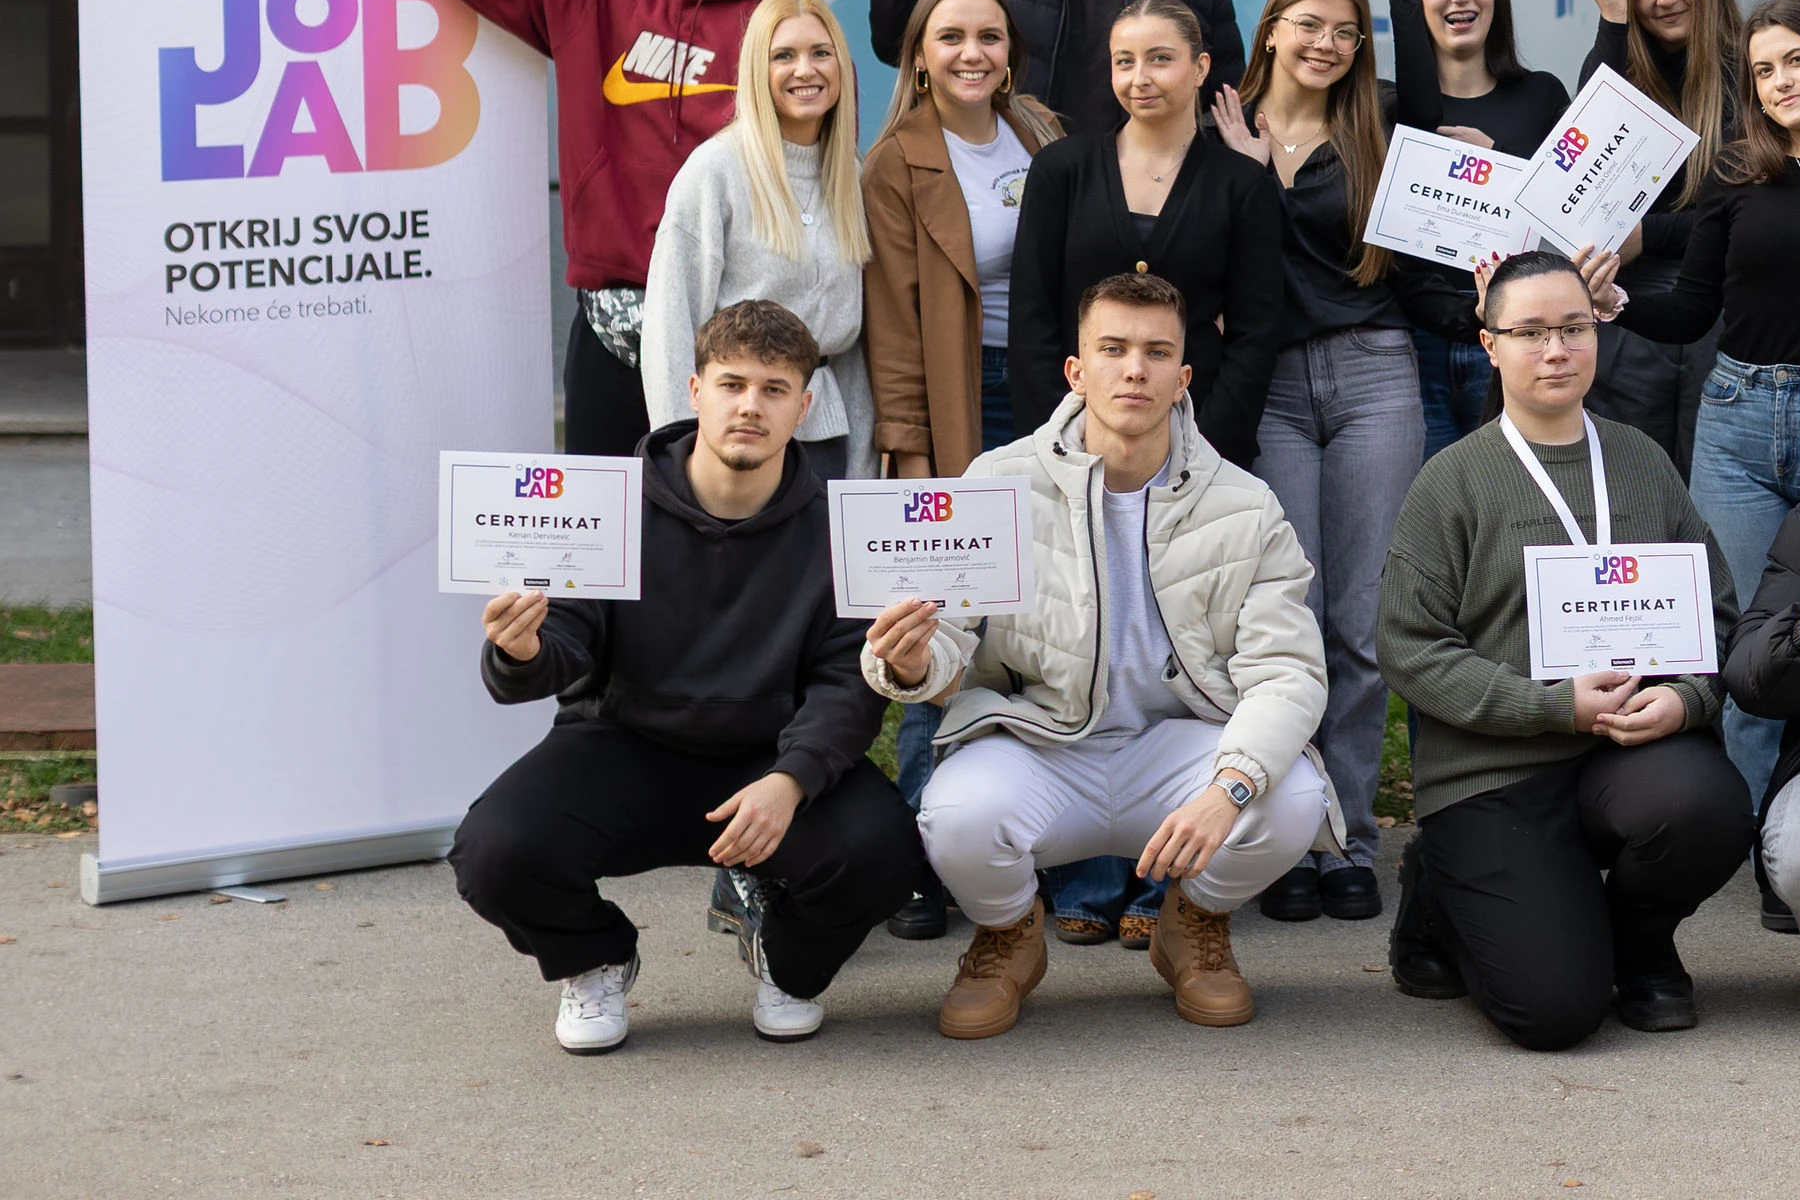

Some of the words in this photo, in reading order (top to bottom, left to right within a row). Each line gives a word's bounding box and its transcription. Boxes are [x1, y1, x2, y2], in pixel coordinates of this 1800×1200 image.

[622, 30, 716, 86] NIKE
[158, 47, 481, 182] LAB
[1555, 131, 1588, 171] LAB
[1448, 161, 1491, 184] LAB
[1561, 123, 1630, 214] CERTIFIKAT
[1410, 183, 1511, 220] CERTIFIKAT
[1437, 205, 1450, 213] Ema
[164, 216, 301, 253] OTKRIJ
[312, 209, 430, 245] SVOJE
[165, 250, 432, 294] POTENCIJALE.
[165, 303, 259, 327] Nekome
[266, 300, 291, 320] će
[299, 294, 373, 318] trebati.
[515, 478, 563, 498] LAB
[476, 514, 601, 530] CERTIFIKAT
[904, 502, 952, 522] LAB
[509, 531, 531, 539] Kenan
[867, 537, 993, 553] CERTIFIKAT
[894, 556, 927, 565] Benjamin
[1594, 566, 1638, 584] LAB
[1562, 598, 1676, 613] CERTIFIKAT
